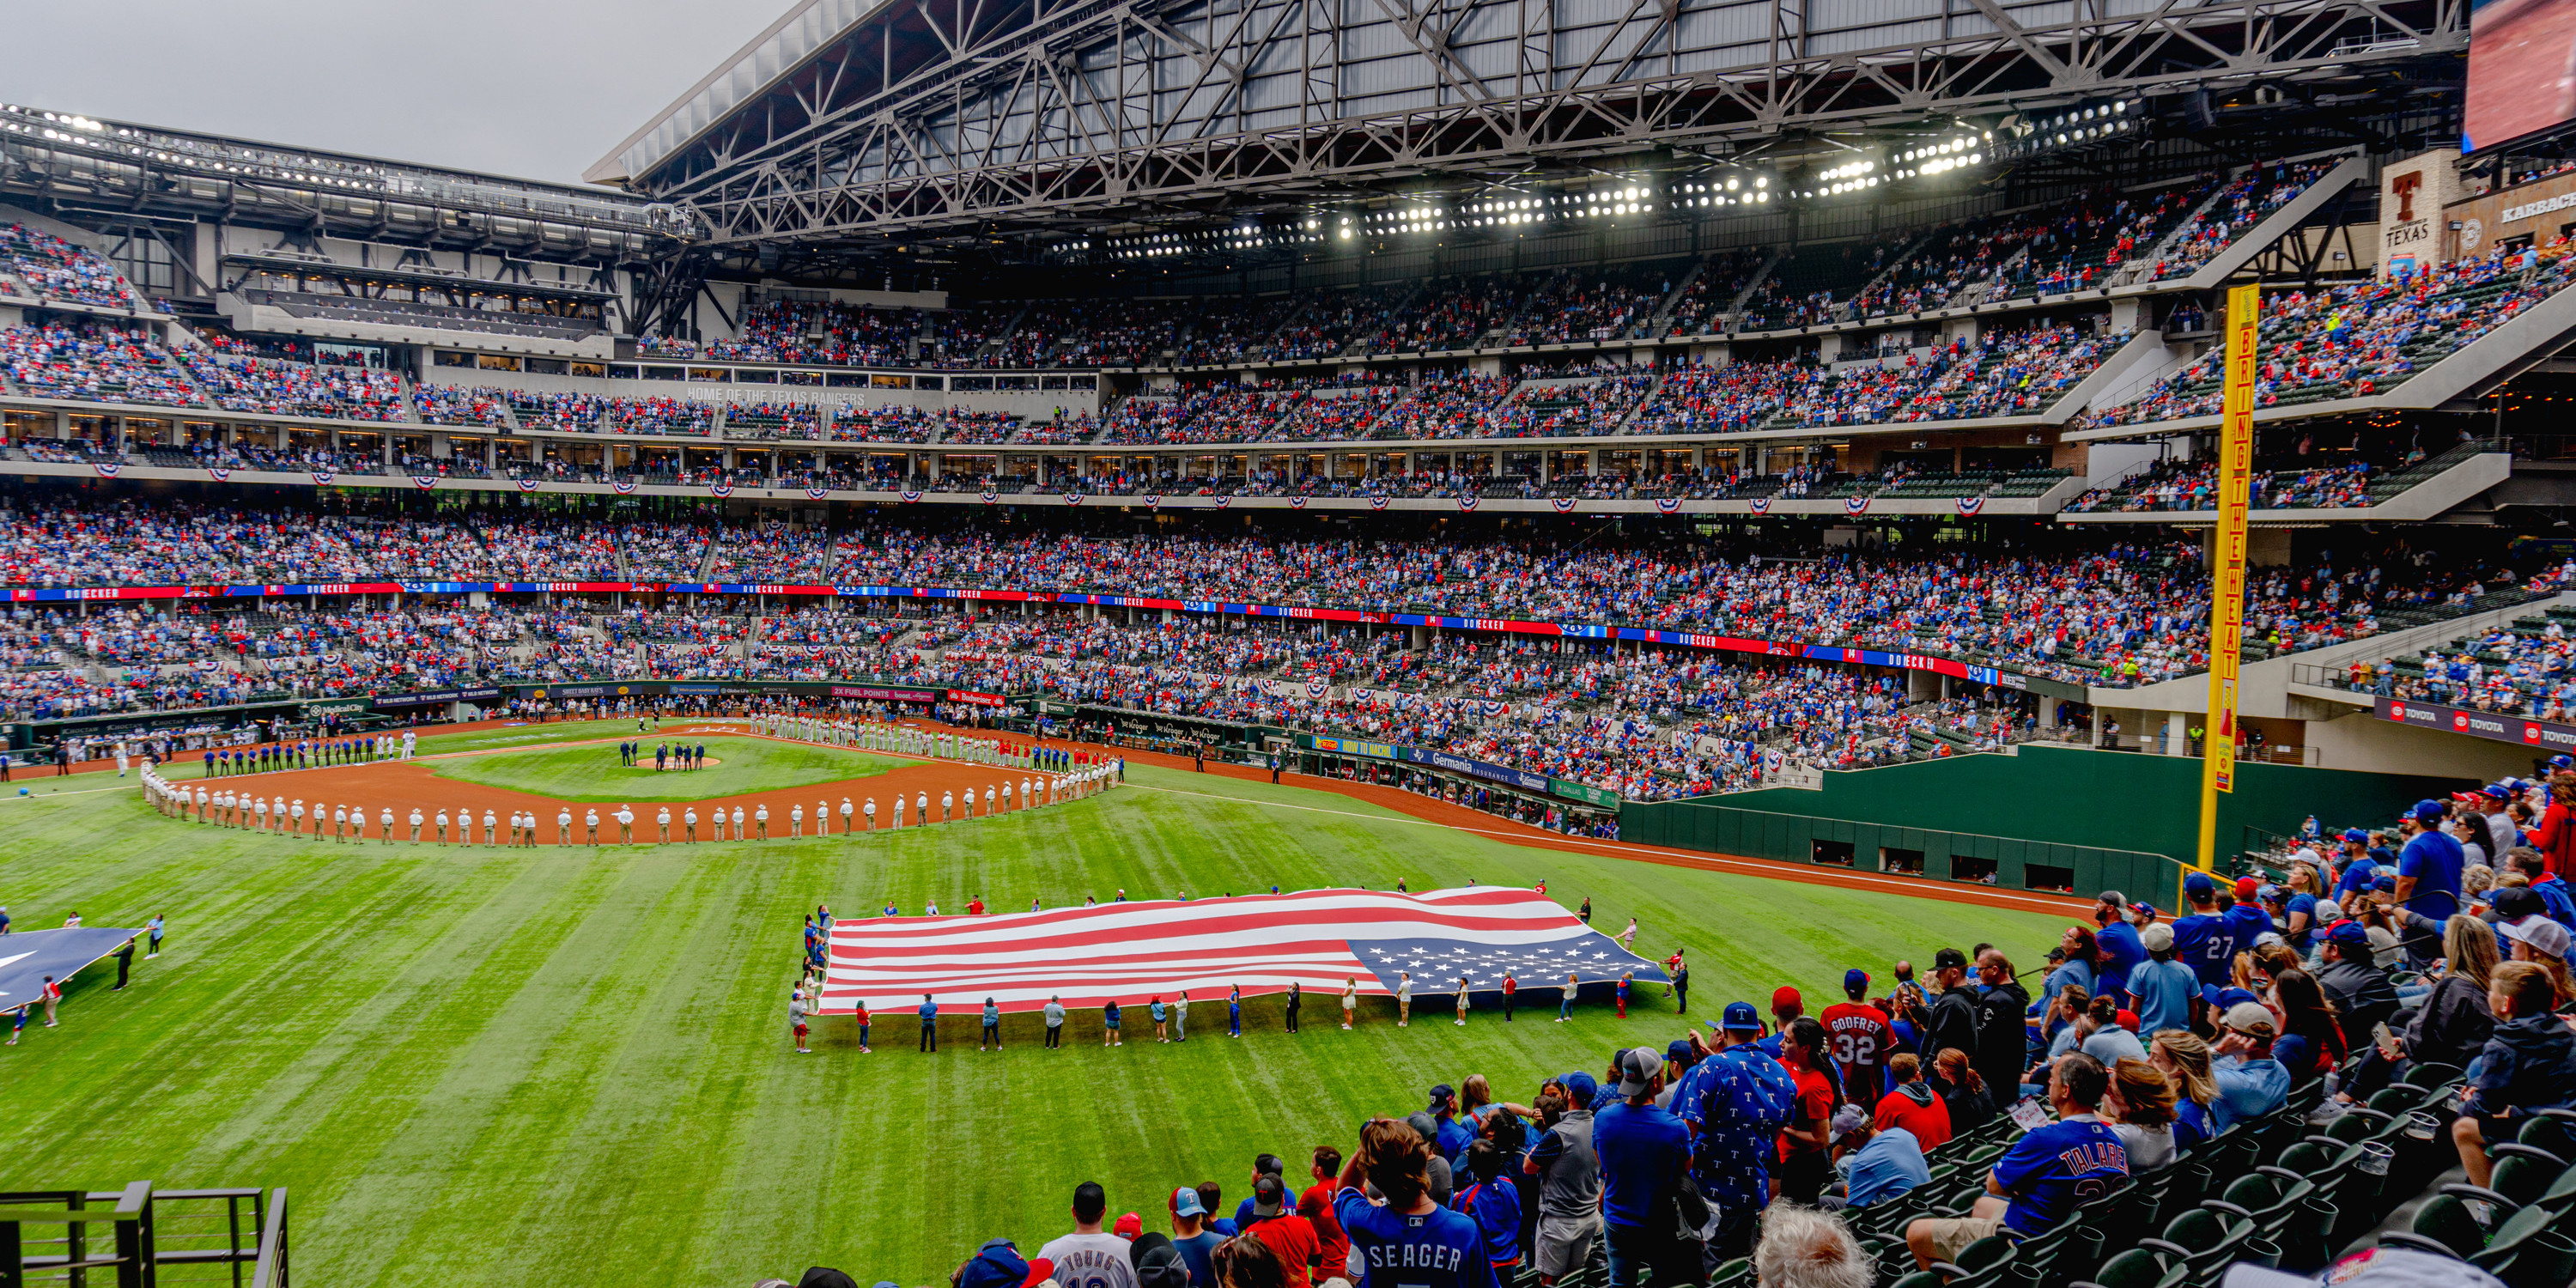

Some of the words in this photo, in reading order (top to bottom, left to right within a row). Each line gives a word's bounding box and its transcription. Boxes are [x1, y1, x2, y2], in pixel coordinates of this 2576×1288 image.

[2386, 223, 2428, 247] TEXAS
[688, 387, 723, 401] HOME
[726, 388, 742, 402] OF
[745, 389, 767, 403] THE
[770, 390, 807, 404] TEXAS
[811, 392, 866, 406] RANGERS
[962, 693, 991, 704] Budweiser
[323, 705, 349, 714] Medical
[349, 704, 364, 713] City
[2405, 708, 2436, 722] TOYOTA
[151, 719, 185, 727] CHOCTAW
[1128, 718, 1149, 734] Kroger
[1163, 723, 1184, 738] Kroger
[2470, 719, 2504, 733] TOYOTA
[1200, 727, 1220, 744] Kroger
[2543, 730, 2576, 744] TOYOTA
[1343, 740, 1358, 753] HOW
[1359, 742, 1368, 754] TO
[1369, 744, 1393, 757] NACHO.
[1432, 752, 1473, 773] Germania
[1473, 769, 1509, 781] INSURANCE
[1564, 786, 1582, 795] DALLAS
[2207, 936, 2234, 959] 27
[1832, 1017, 1881, 1035] GODFREY
[1835, 1034, 1875, 1065] 32
[1063, 1249, 1117, 1272] YOUNG
[1370, 1243, 1461, 1273] SEAGER
